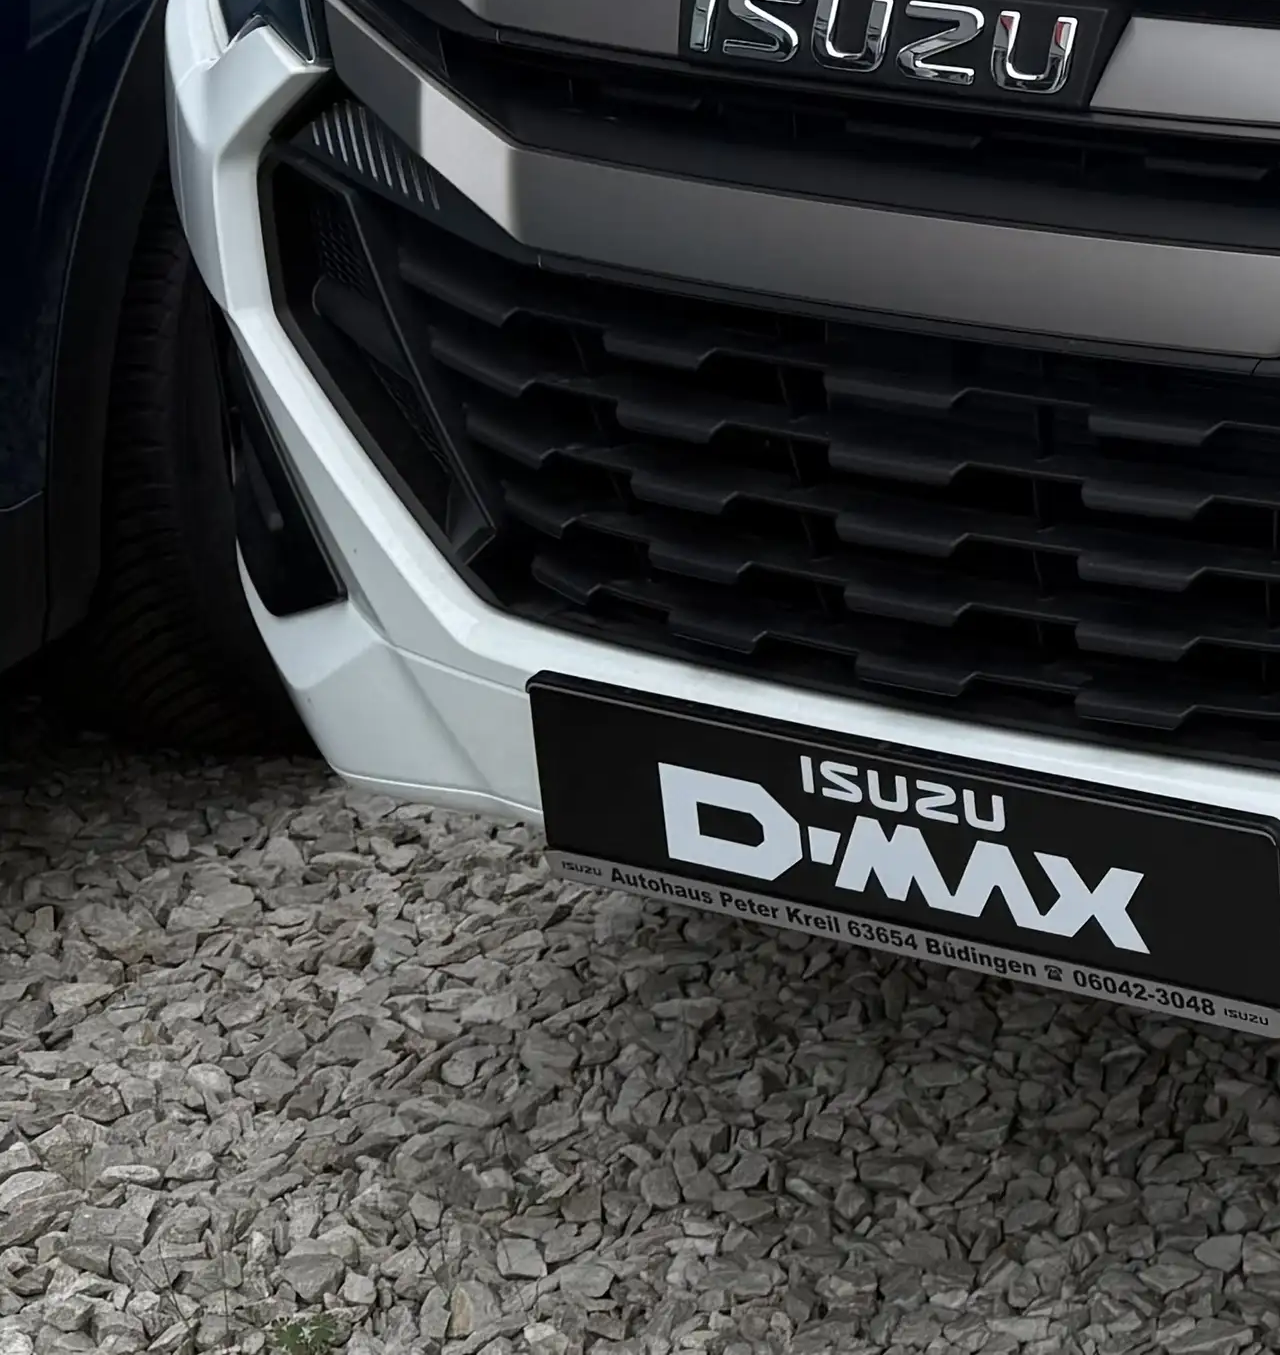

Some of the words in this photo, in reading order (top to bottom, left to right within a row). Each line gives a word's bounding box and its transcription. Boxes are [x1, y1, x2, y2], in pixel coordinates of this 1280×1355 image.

[658, 762, 1150, 954] D-MAX
[800, 755, 1006, 832] ISUZU
[561, 860, 602, 876] ISUZU
[611, 867, 713, 904] Autohaus
[719, 891, 779, 920] Peter
[785, 905, 840, 934] Kreil
[847, 920, 919, 951] 63654
[925, 937, 1037, 977] Büdingen
[1072, 969, 1216, 1016] 06042-3048
[1223, 1008, 1269, 1026] ISUZU
